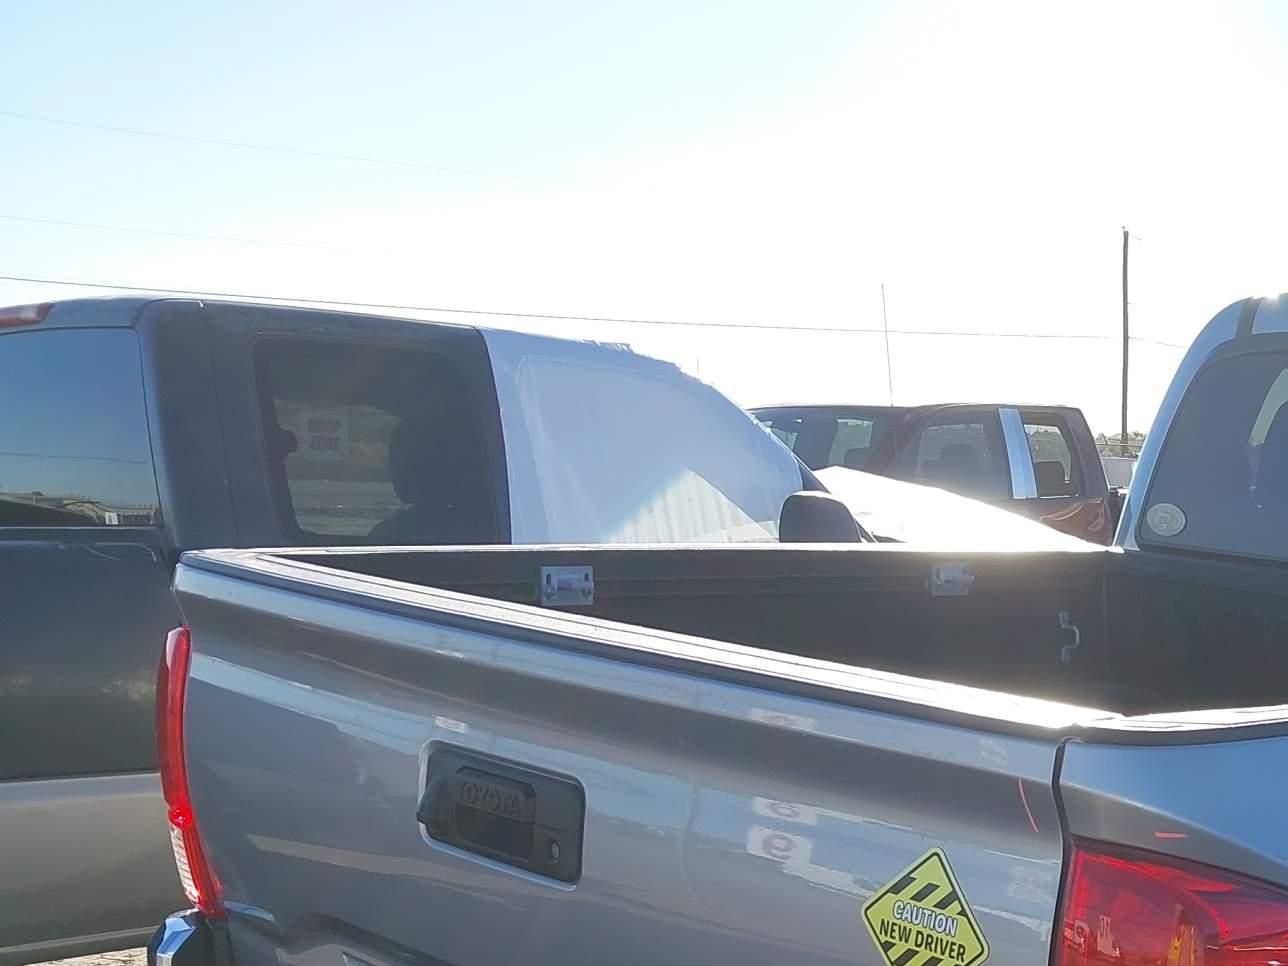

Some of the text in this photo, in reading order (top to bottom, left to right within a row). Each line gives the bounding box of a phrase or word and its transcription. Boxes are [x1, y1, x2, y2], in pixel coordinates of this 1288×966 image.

[455, 781, 526, 821] TOYOTA
[892, 900, 959, 938] CAUTION
[879, 919, 967, 963] NEW DRIVER
